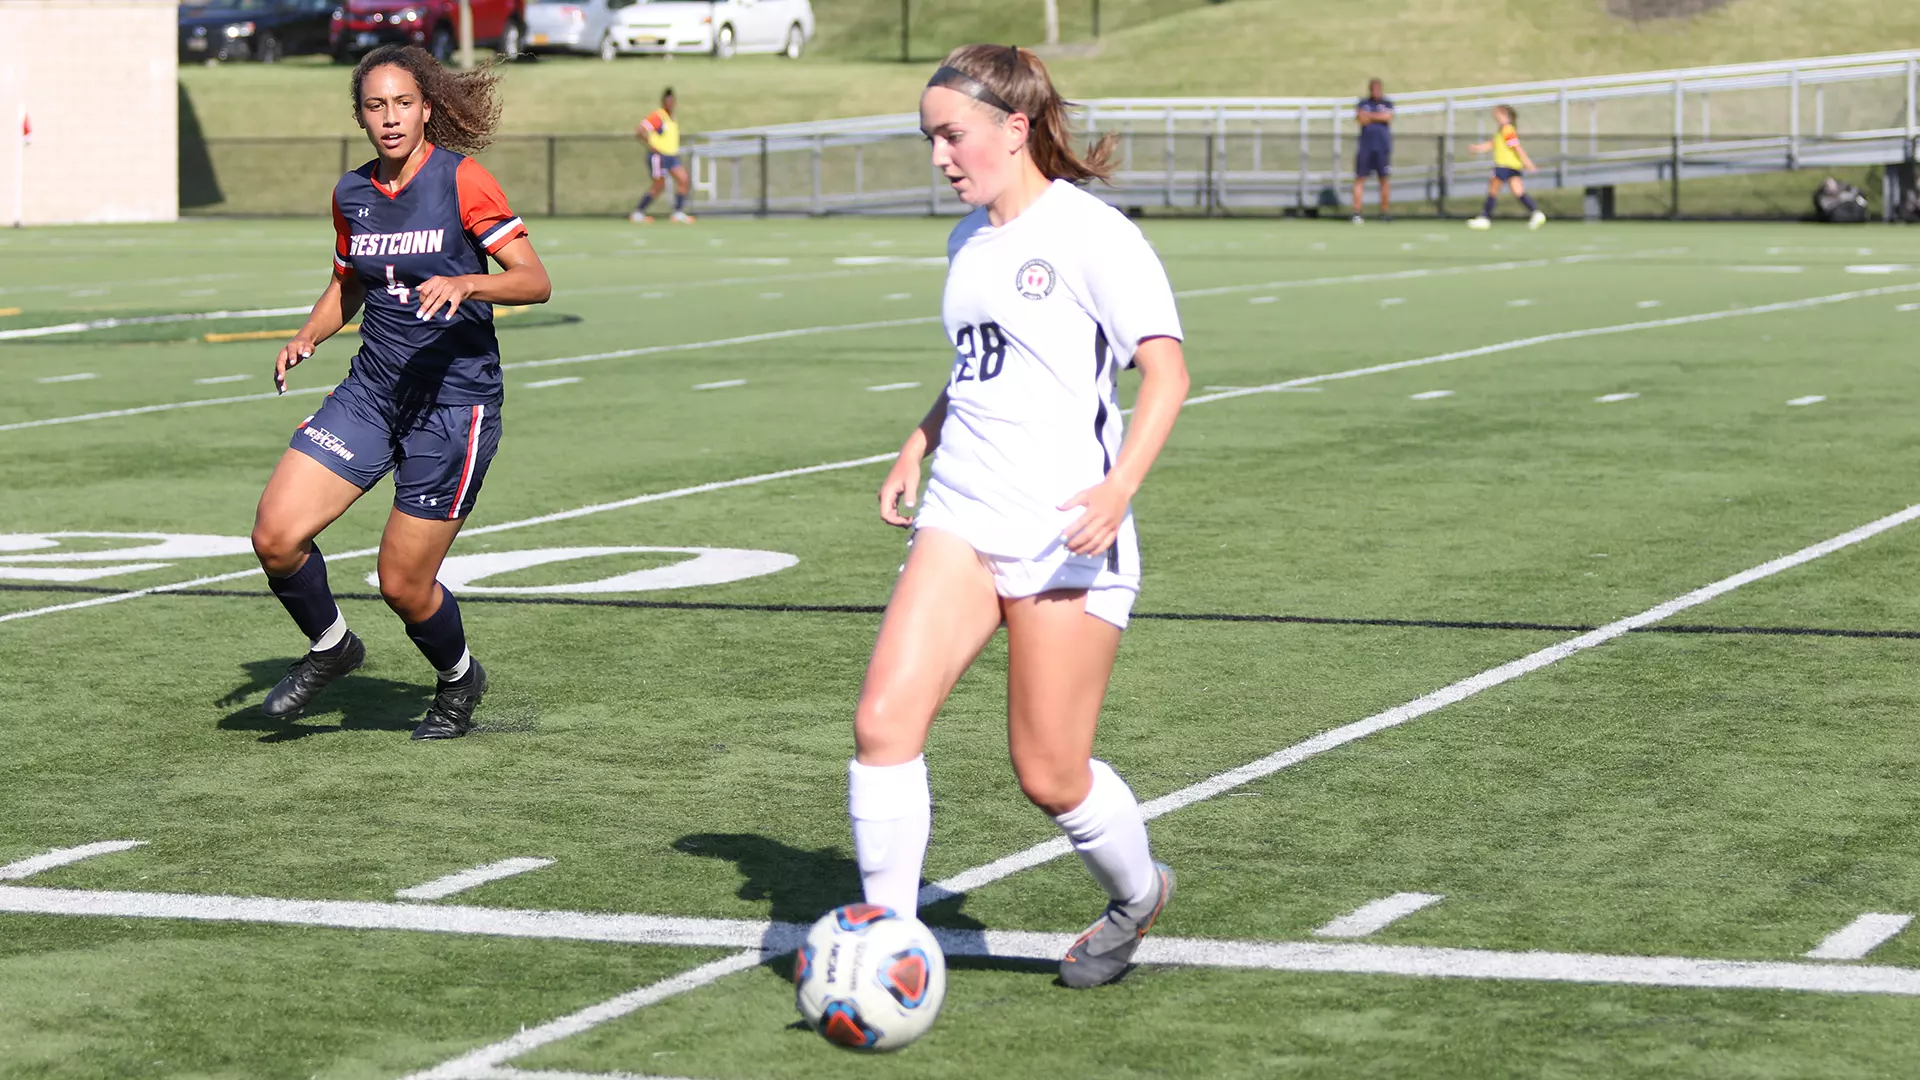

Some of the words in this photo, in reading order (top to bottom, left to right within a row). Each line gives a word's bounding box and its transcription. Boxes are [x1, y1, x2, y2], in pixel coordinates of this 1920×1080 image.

[350, 229, 444, 255] WESTCONN
[386, 264, 410, 304] 4
[956, 321, 1007, 382] 28
